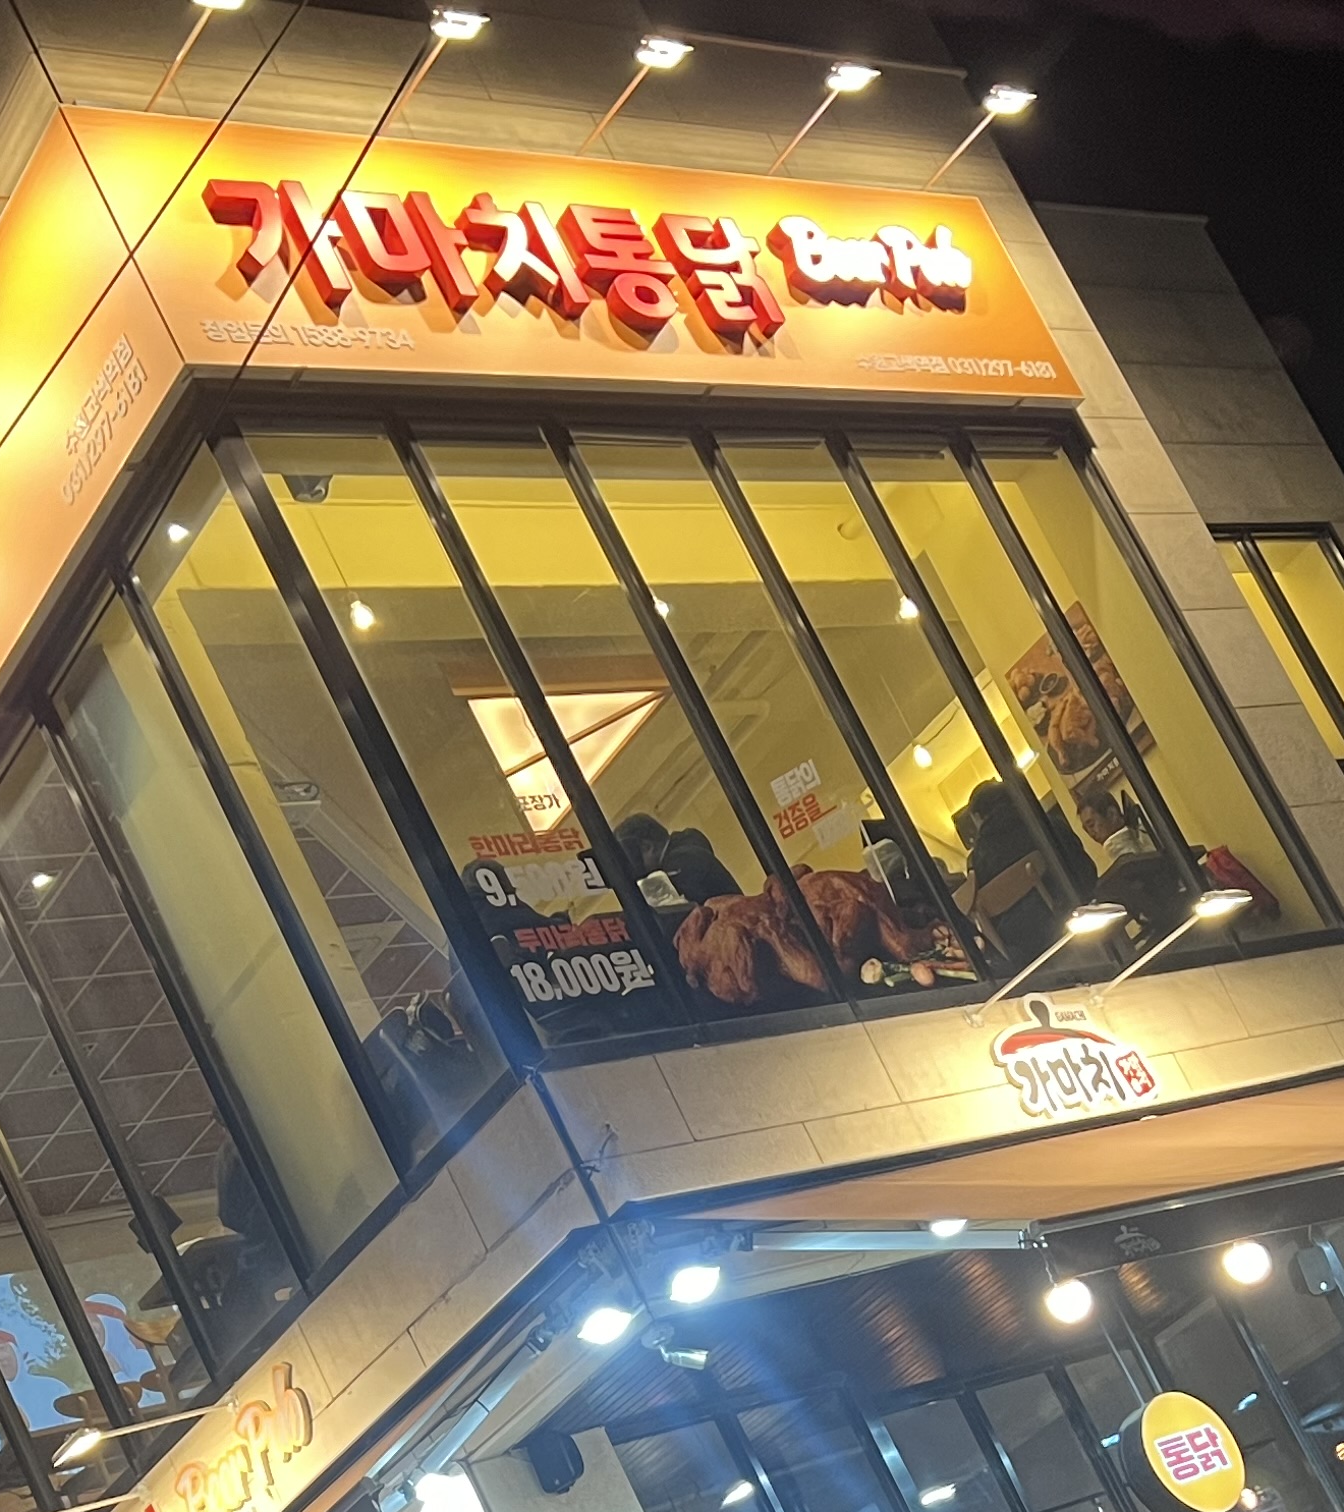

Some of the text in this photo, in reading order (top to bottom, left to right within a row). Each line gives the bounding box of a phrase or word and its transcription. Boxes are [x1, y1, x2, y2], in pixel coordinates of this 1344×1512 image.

[202, 178, 786, 341] 가마치통닭
[773, 793, 838, 839] 검증을
[510, 949, 655, 1003] 18,000원
[1014, 1043, 1126, 1111] 가마치
[1156, 1426, 1230, 1482] 통닭
